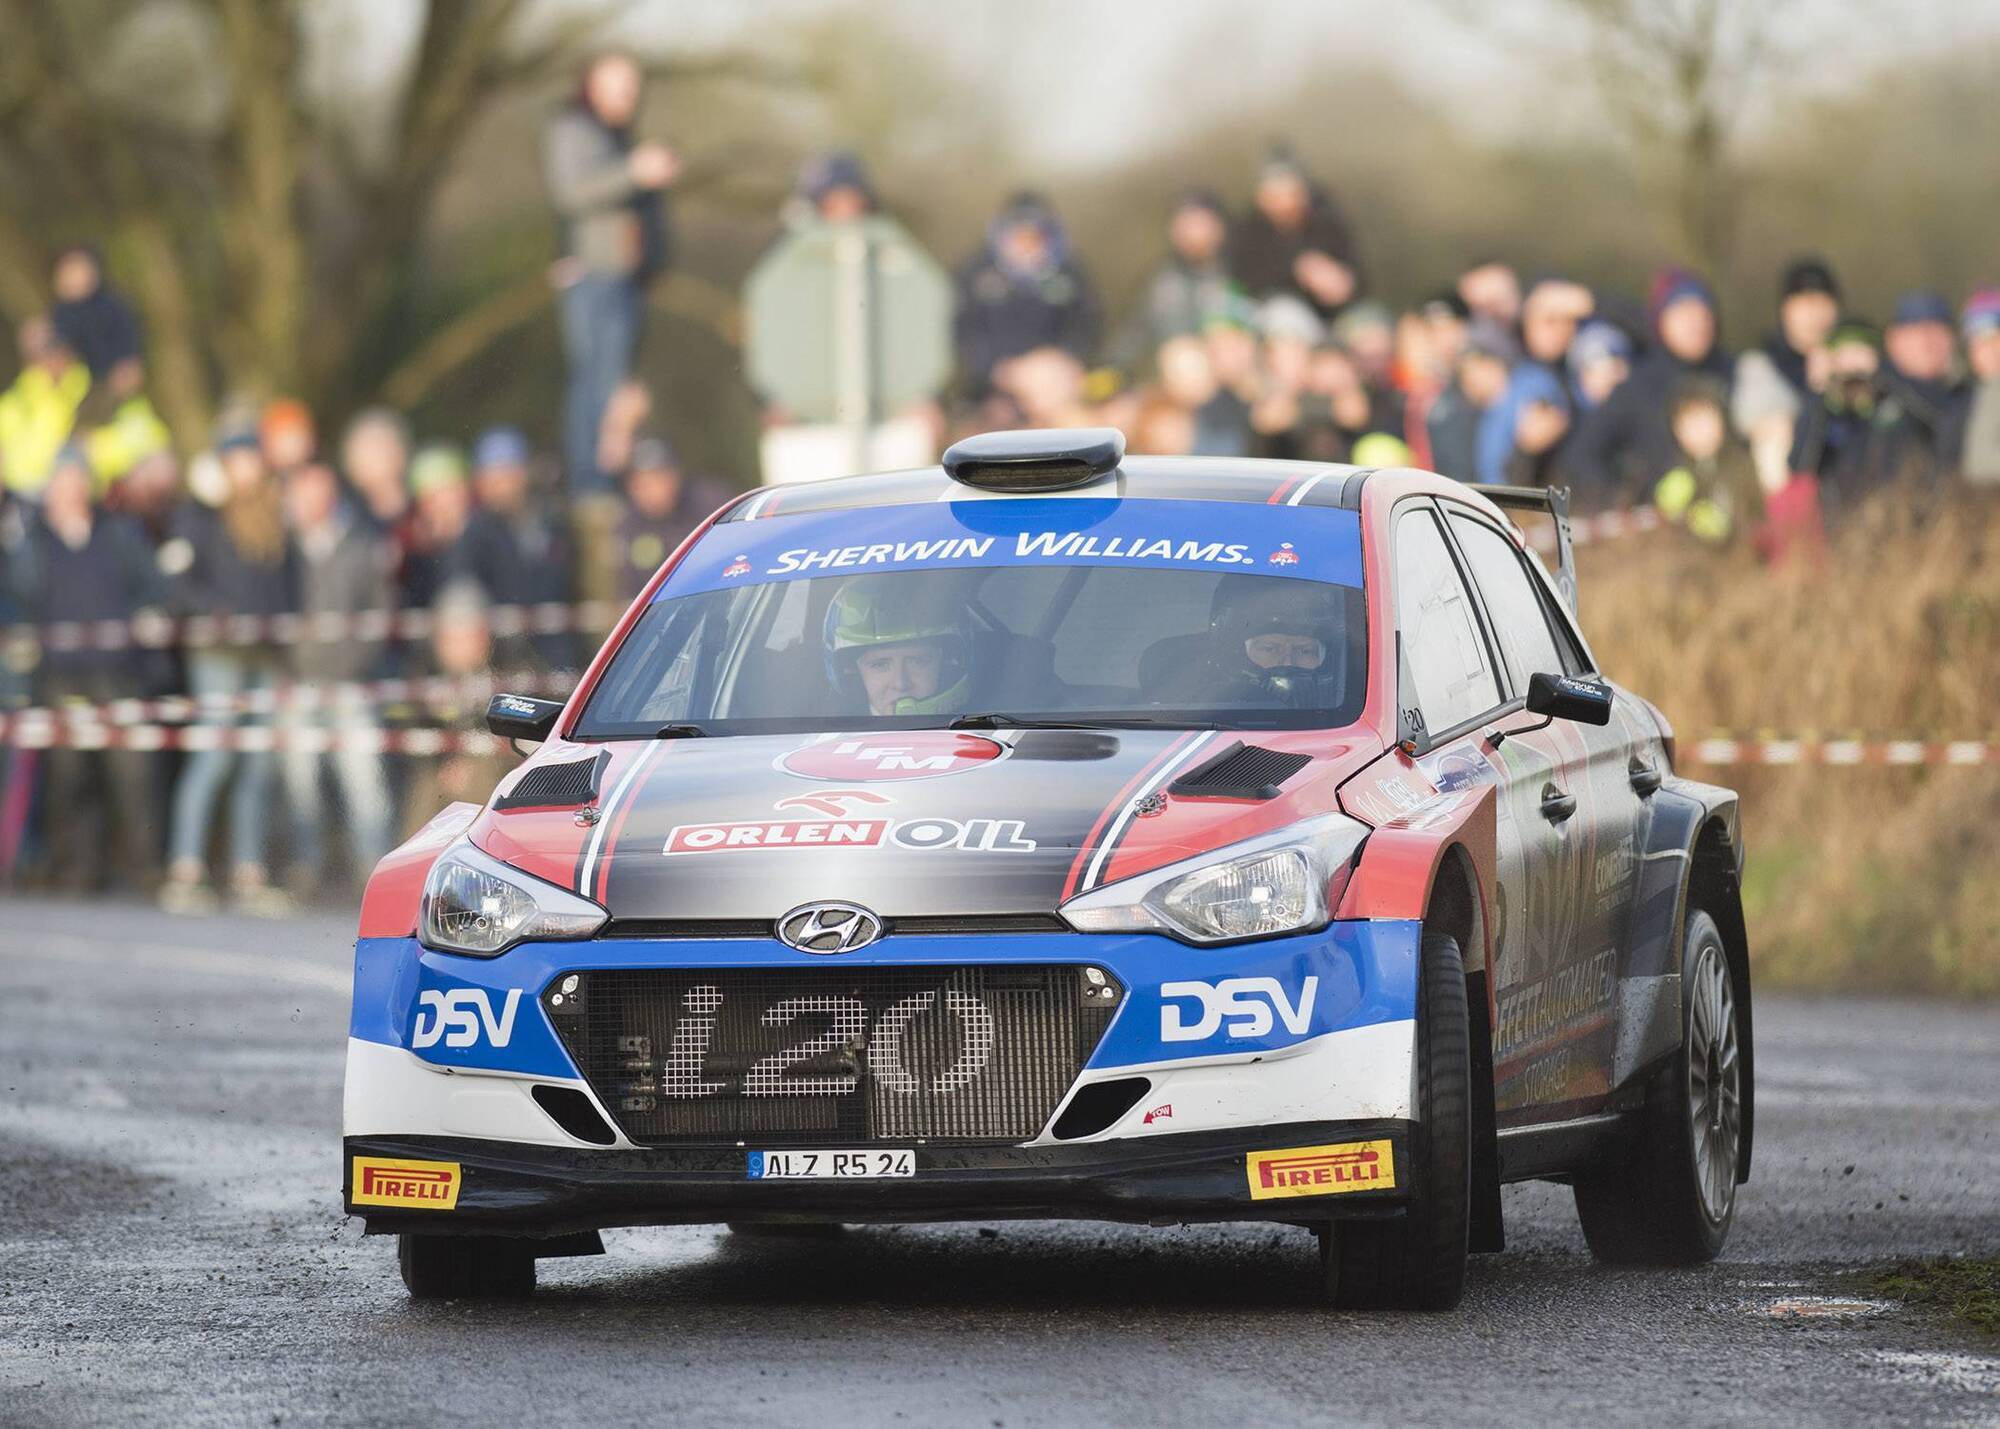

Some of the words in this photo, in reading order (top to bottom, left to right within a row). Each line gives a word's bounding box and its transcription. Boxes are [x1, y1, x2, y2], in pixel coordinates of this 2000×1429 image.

[767, 538, 995, 574] SHERWIN
[683, 824, 868, 847] ORLEN
[890, 818, 1036, 852] OIL
[412, 988, 523, 1048] DSV
[1161, 976, 1318, 1042] DSV
[661, 984, 994, 1098] i20
[1152, 1106, 1170, 1117] TOW
[833, 1154, 867, 1175] R5
[877, 1153, 910, 1175] 24
[1259, 1151, 1379, 1188] PIRELLI
[363, 1166, 452, 1200] PIRELLI
